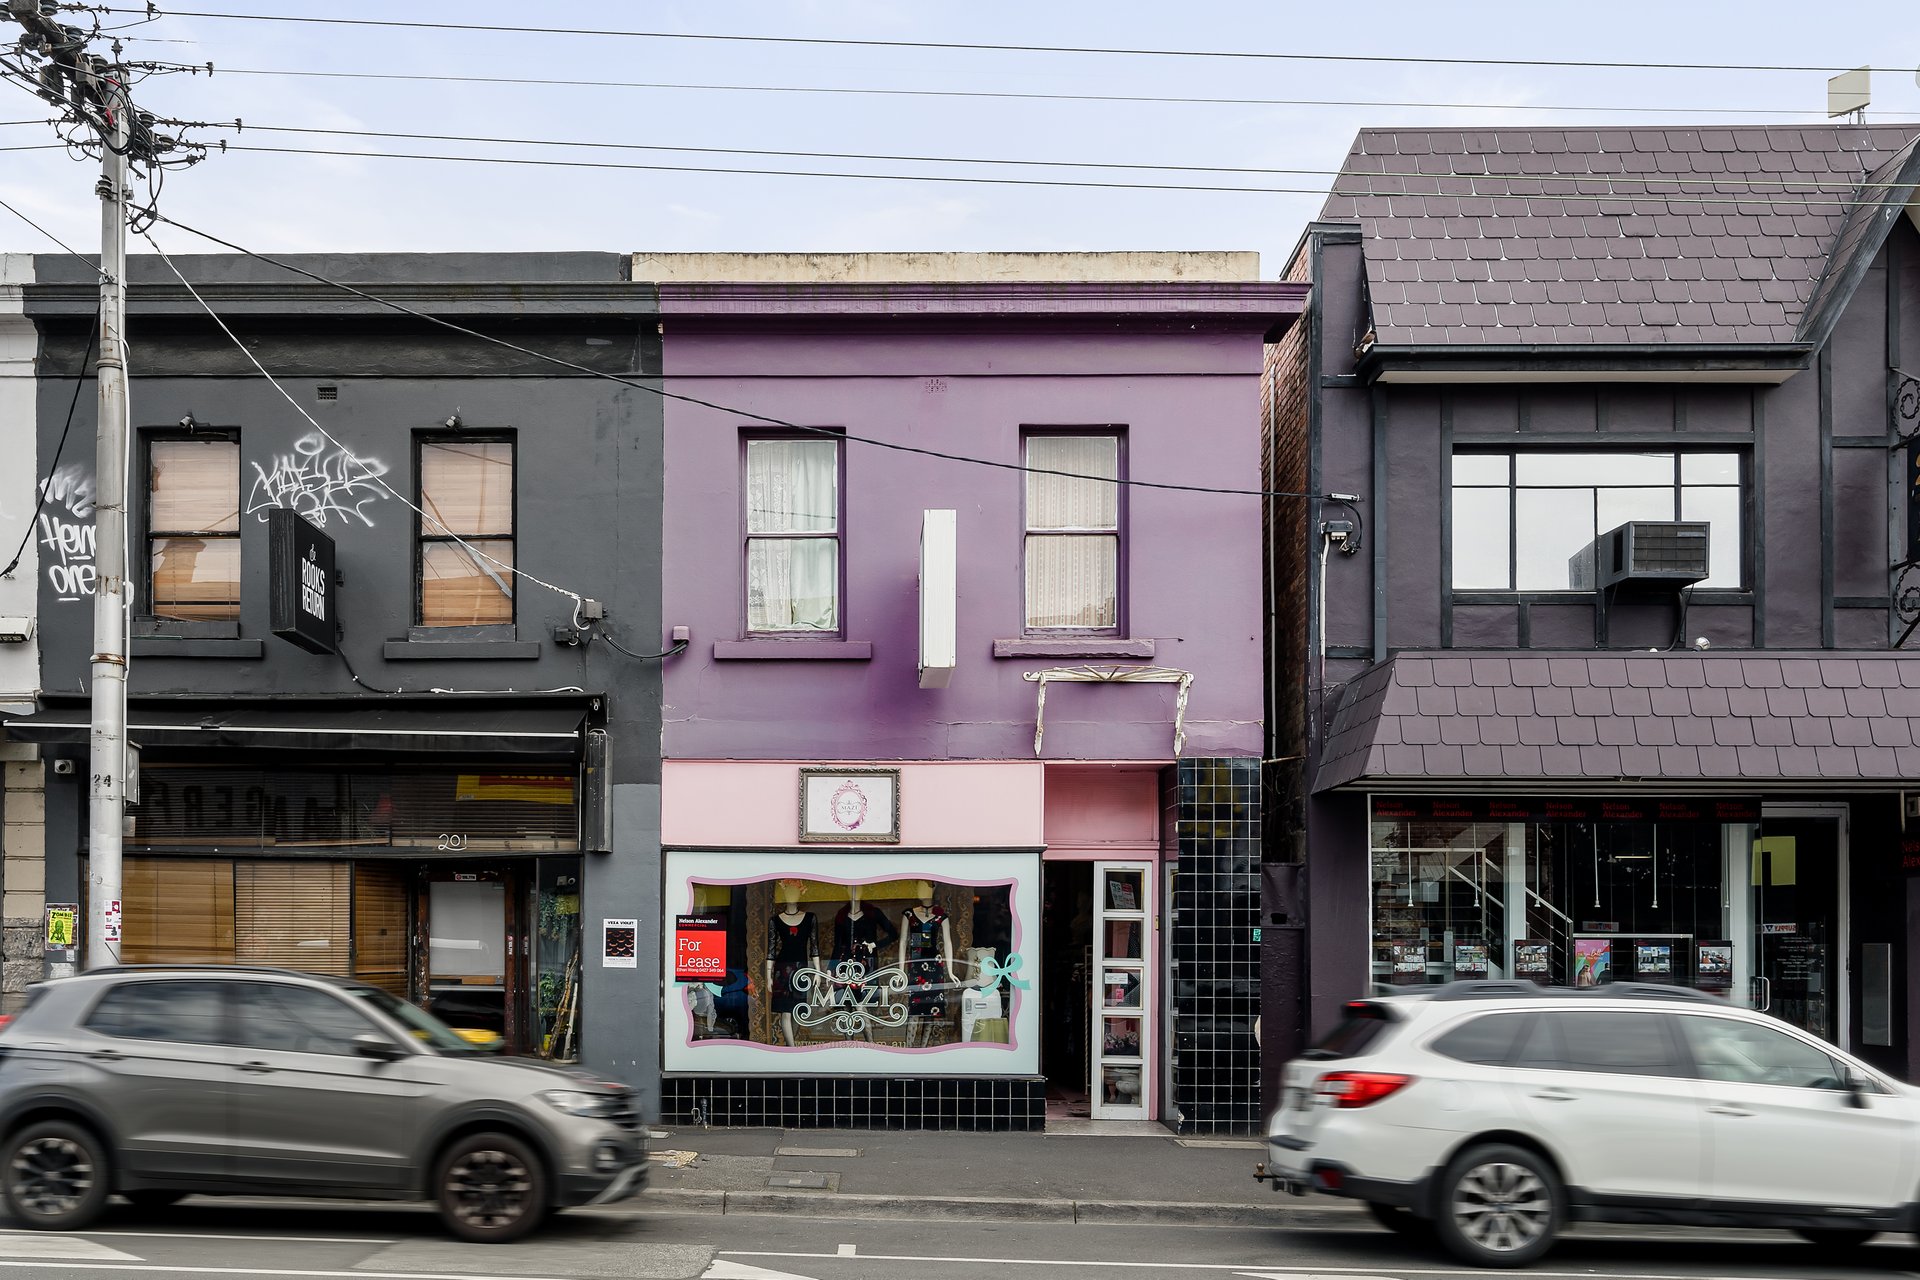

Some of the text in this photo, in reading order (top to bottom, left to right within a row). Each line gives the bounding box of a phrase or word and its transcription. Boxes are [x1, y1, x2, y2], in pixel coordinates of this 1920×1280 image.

[302, 557, 325, 595] ROOKS
[302, 583, 325, 621] RETURN
[438, 833, 467, 850] 201
[679, 938, 702, 951] For
[679, 954, 720, 968] Lease
[810, 984, 892, 1008] MAZI
